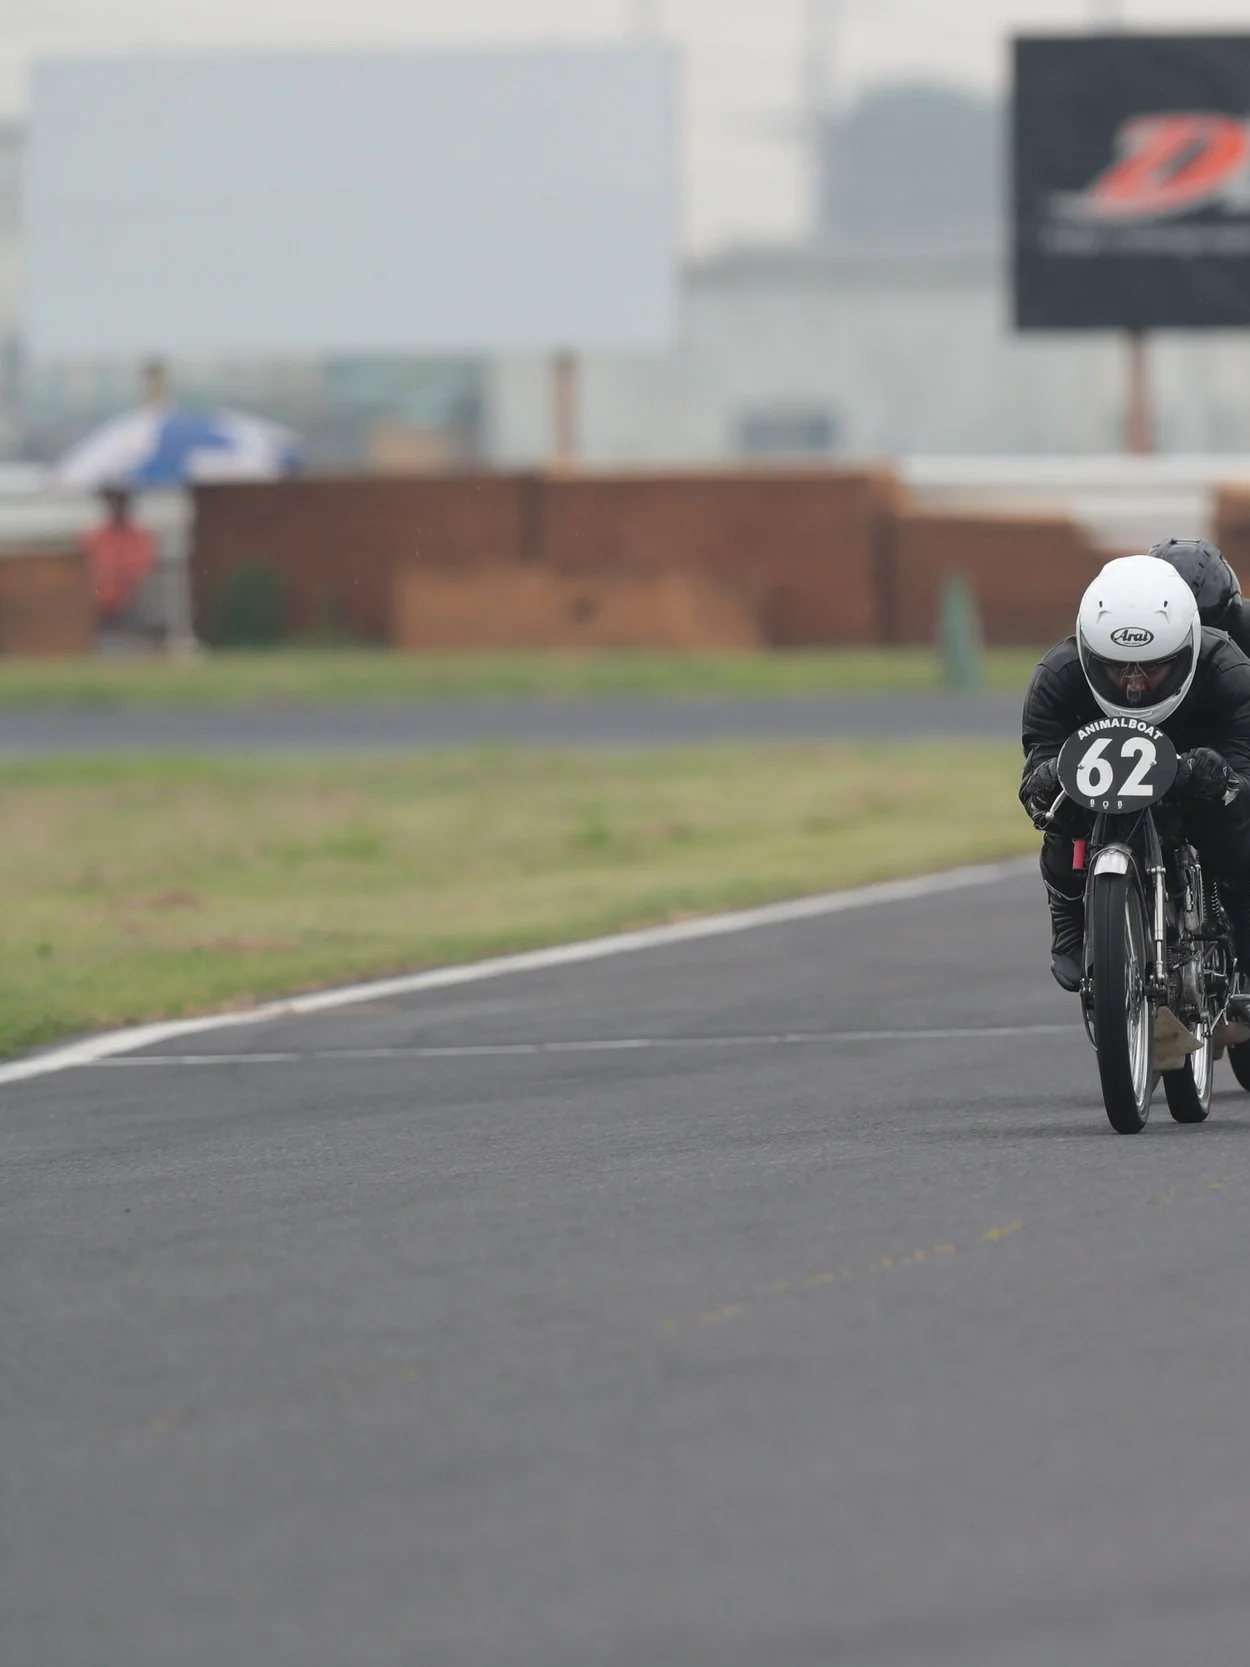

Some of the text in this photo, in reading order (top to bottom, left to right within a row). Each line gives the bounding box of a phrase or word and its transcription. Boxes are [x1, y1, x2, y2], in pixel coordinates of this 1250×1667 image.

[1112, 629, 1149, 642] Arai
[1077, 717, 1163, 741] ANIMALBOAT
[1076, 736, 1158, 797] 62
